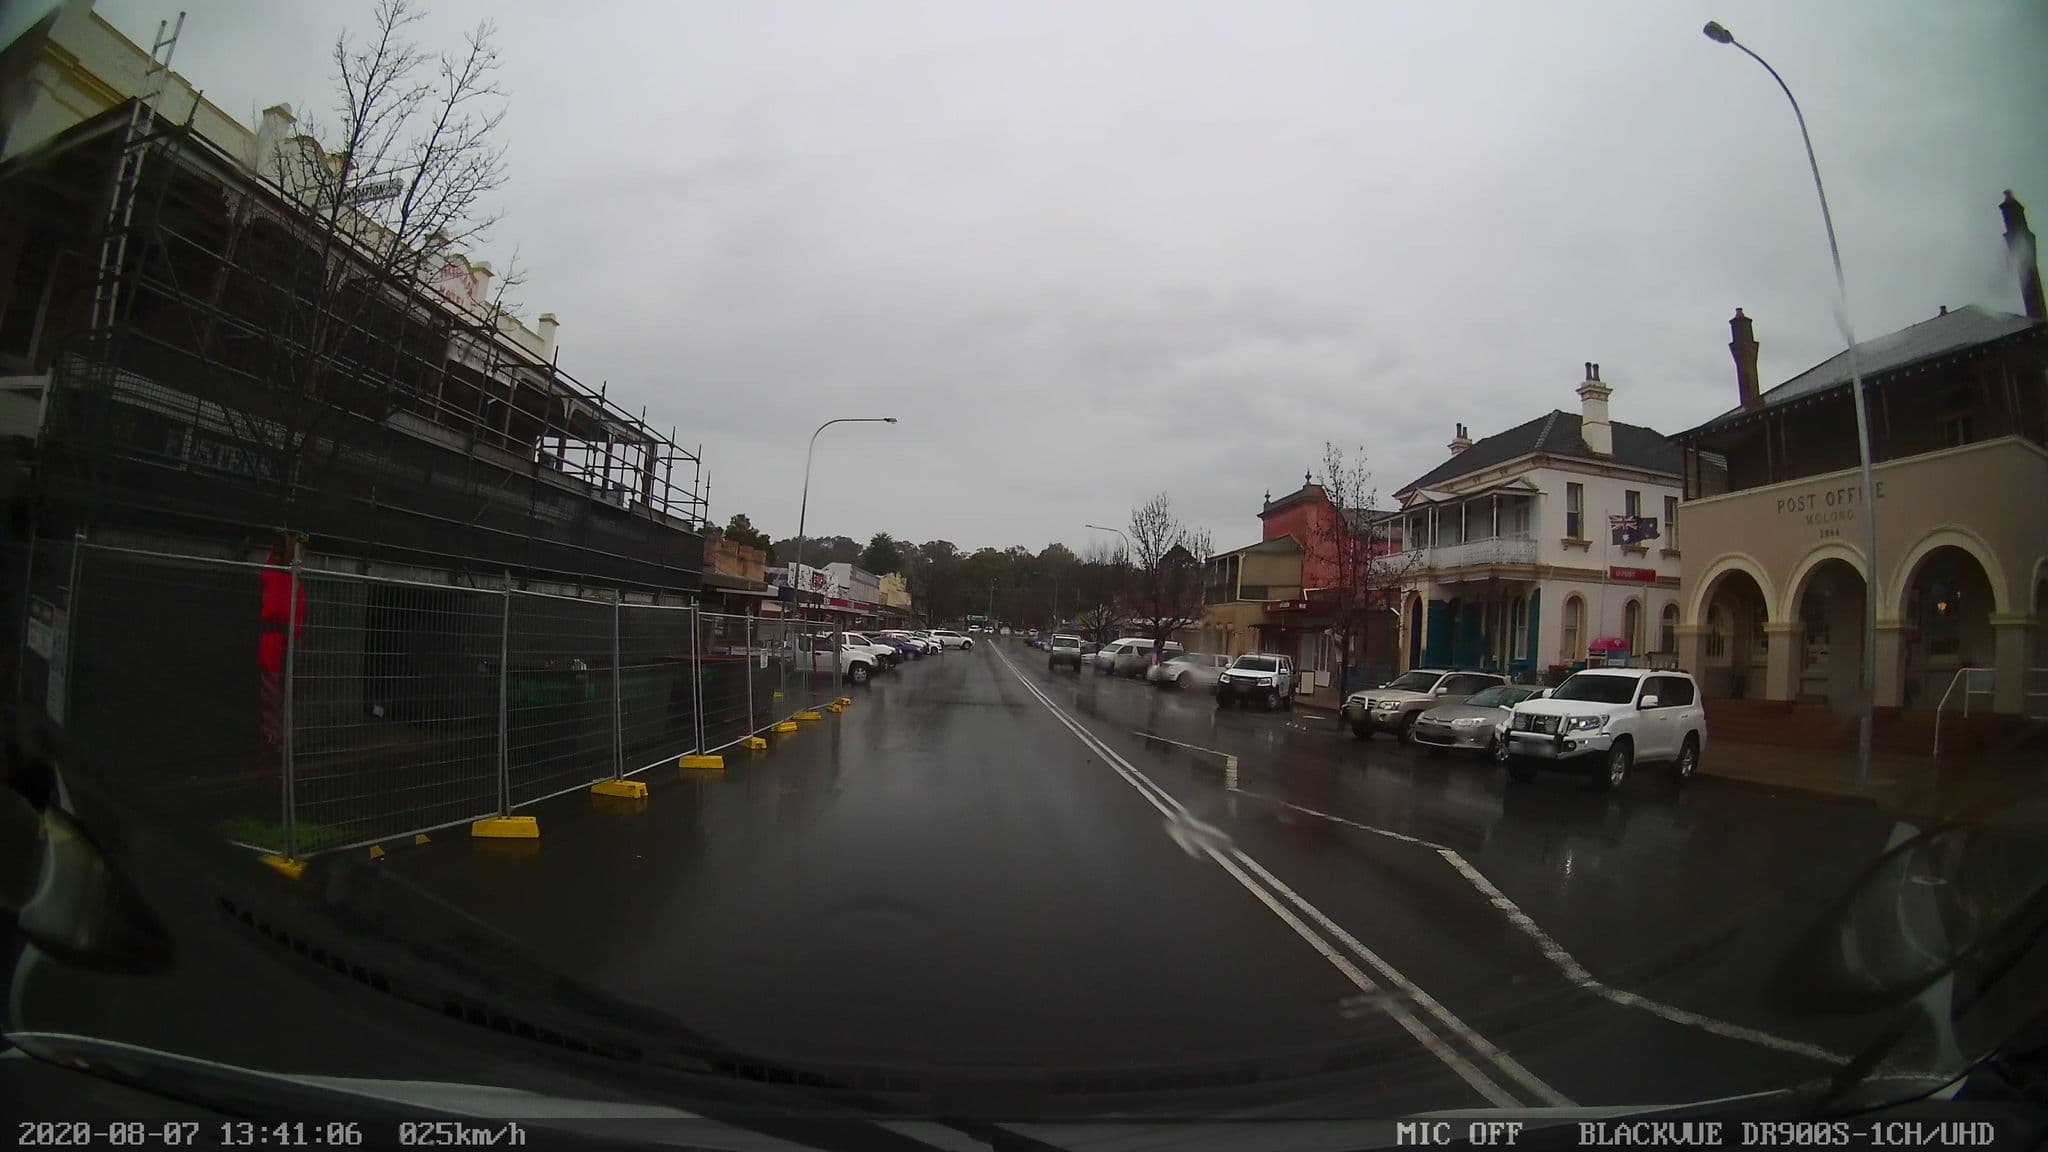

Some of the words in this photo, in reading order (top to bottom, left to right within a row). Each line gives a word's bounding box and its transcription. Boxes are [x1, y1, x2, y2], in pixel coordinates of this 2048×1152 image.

[1777, 494, 1816, 514] POST
[1826, 482, 1885, 506] OFFIE
[1806, 509, 1854, 525] MOLONG
